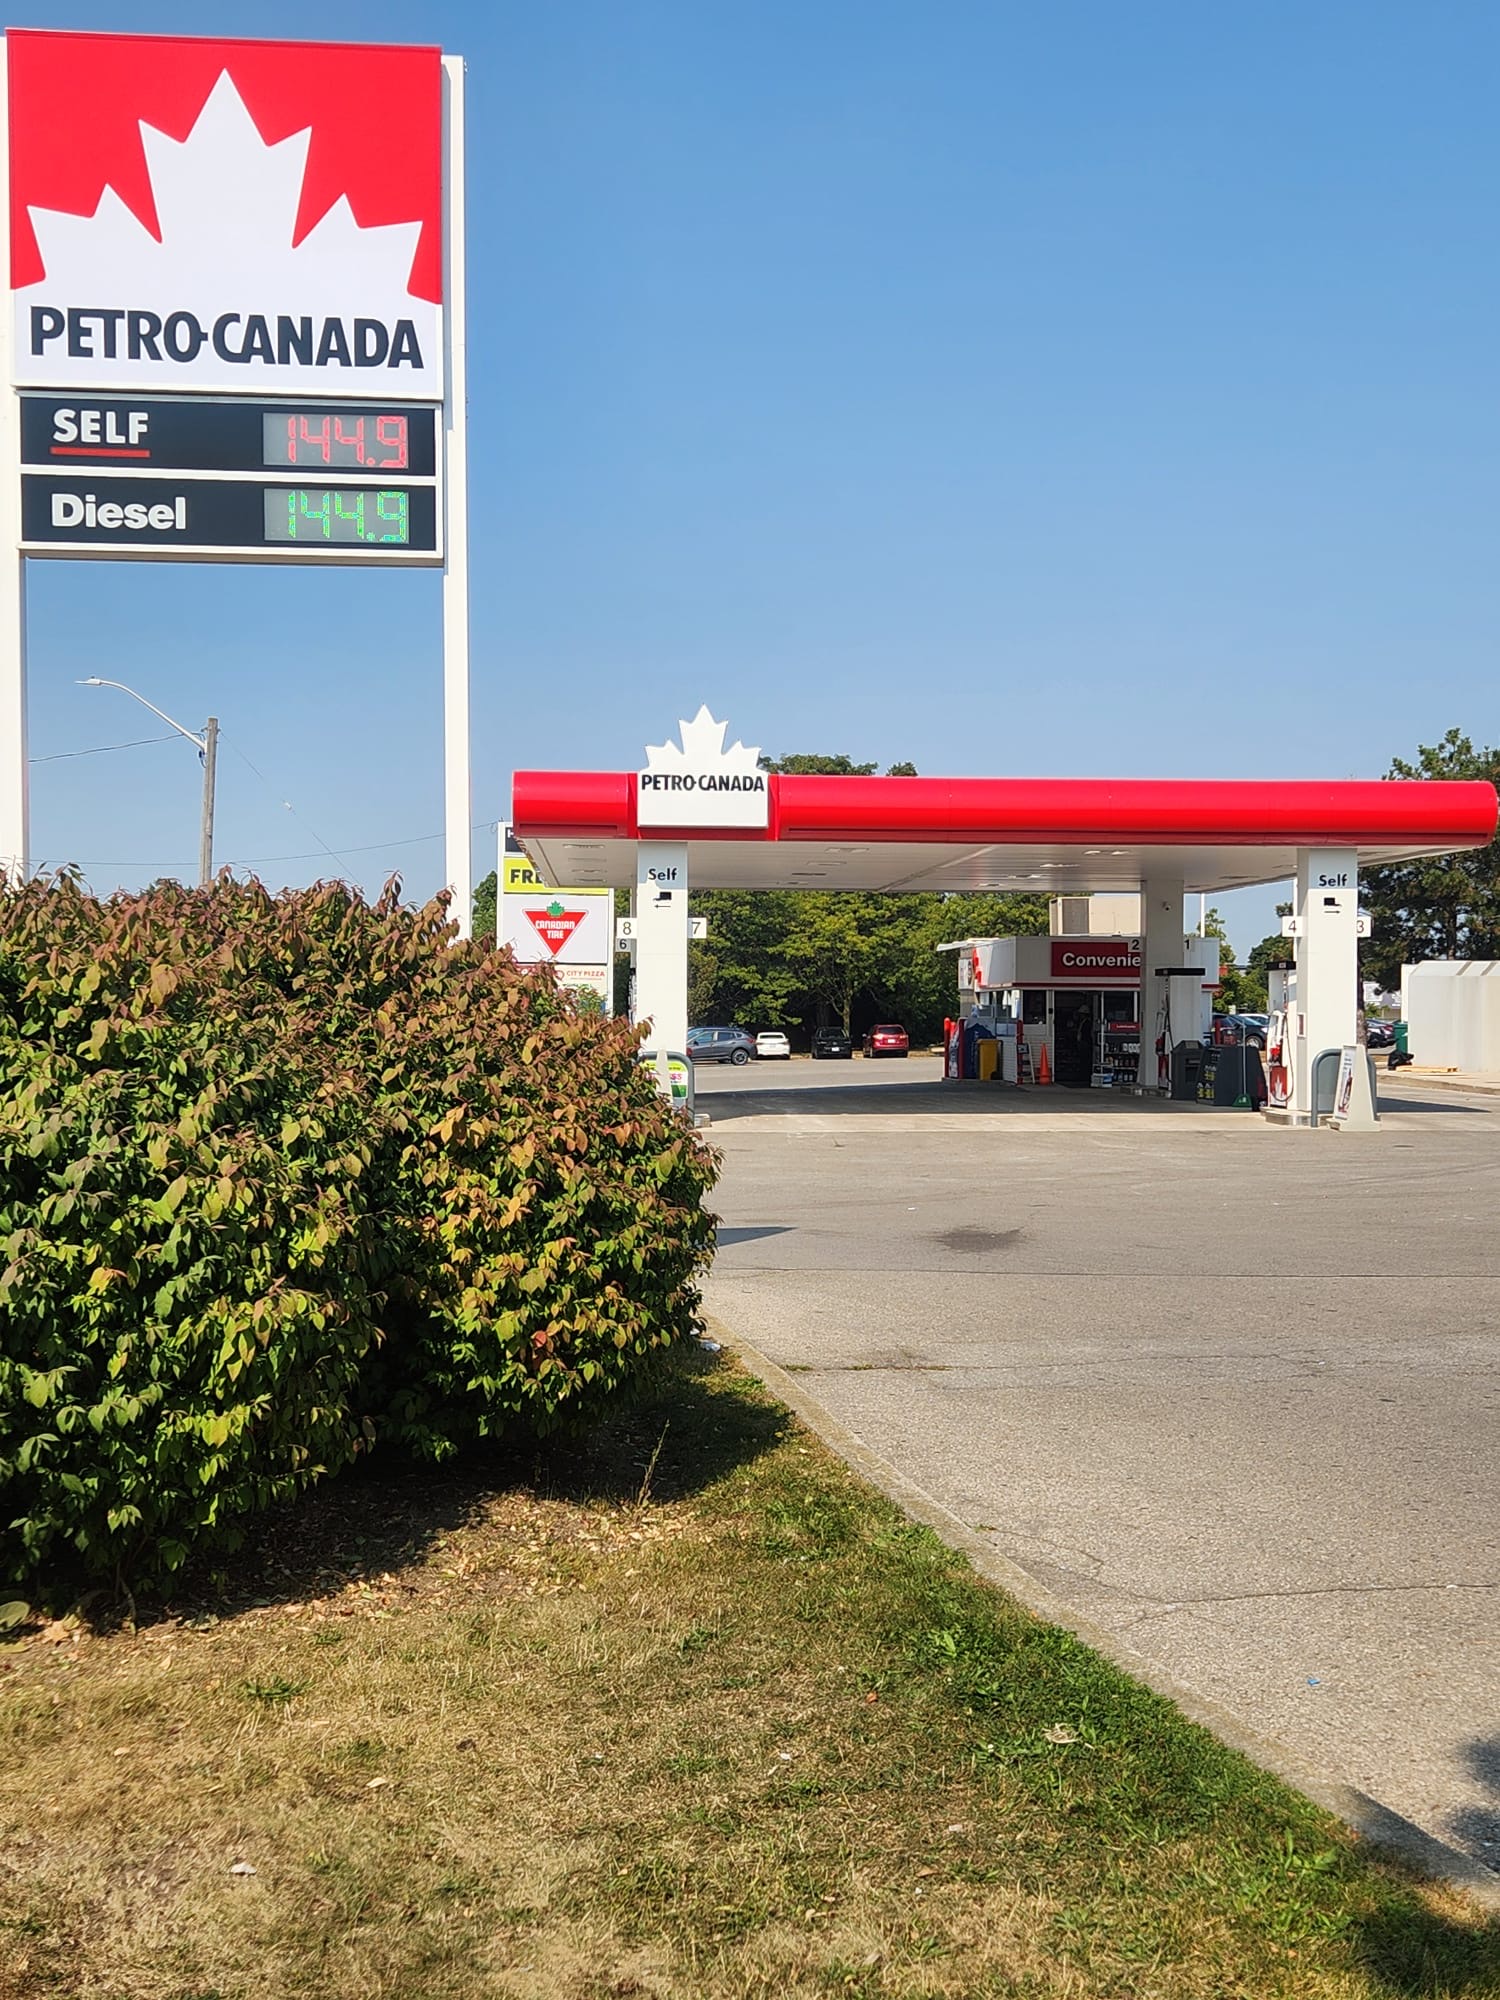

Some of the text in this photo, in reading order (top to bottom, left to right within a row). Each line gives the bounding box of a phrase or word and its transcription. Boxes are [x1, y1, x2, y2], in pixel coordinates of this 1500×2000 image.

[53, 409, 150, 444] SELF
[287, 415, 408, 468] 144.9
[51, 494, 187, 530] Diesel
[287, 491, 408, 543] 144.9
[648, 868, 677, 881] Self
[1319, 873, 1347, 887] Self
[535, 920, 575, 930] CANADIAN
[623, 921, 632, 936] 8
[691, 921, 701, 935] 7
[1288, 920, 1297, 934] 4
[1356, 920, 1365, 934] 3
[547, 930, 564, 939] TIRE
[619, 938, 627, 950] 6
[1131, 939, 1140, 951] 2
[1062, 952, 1141, 967] Convenie
